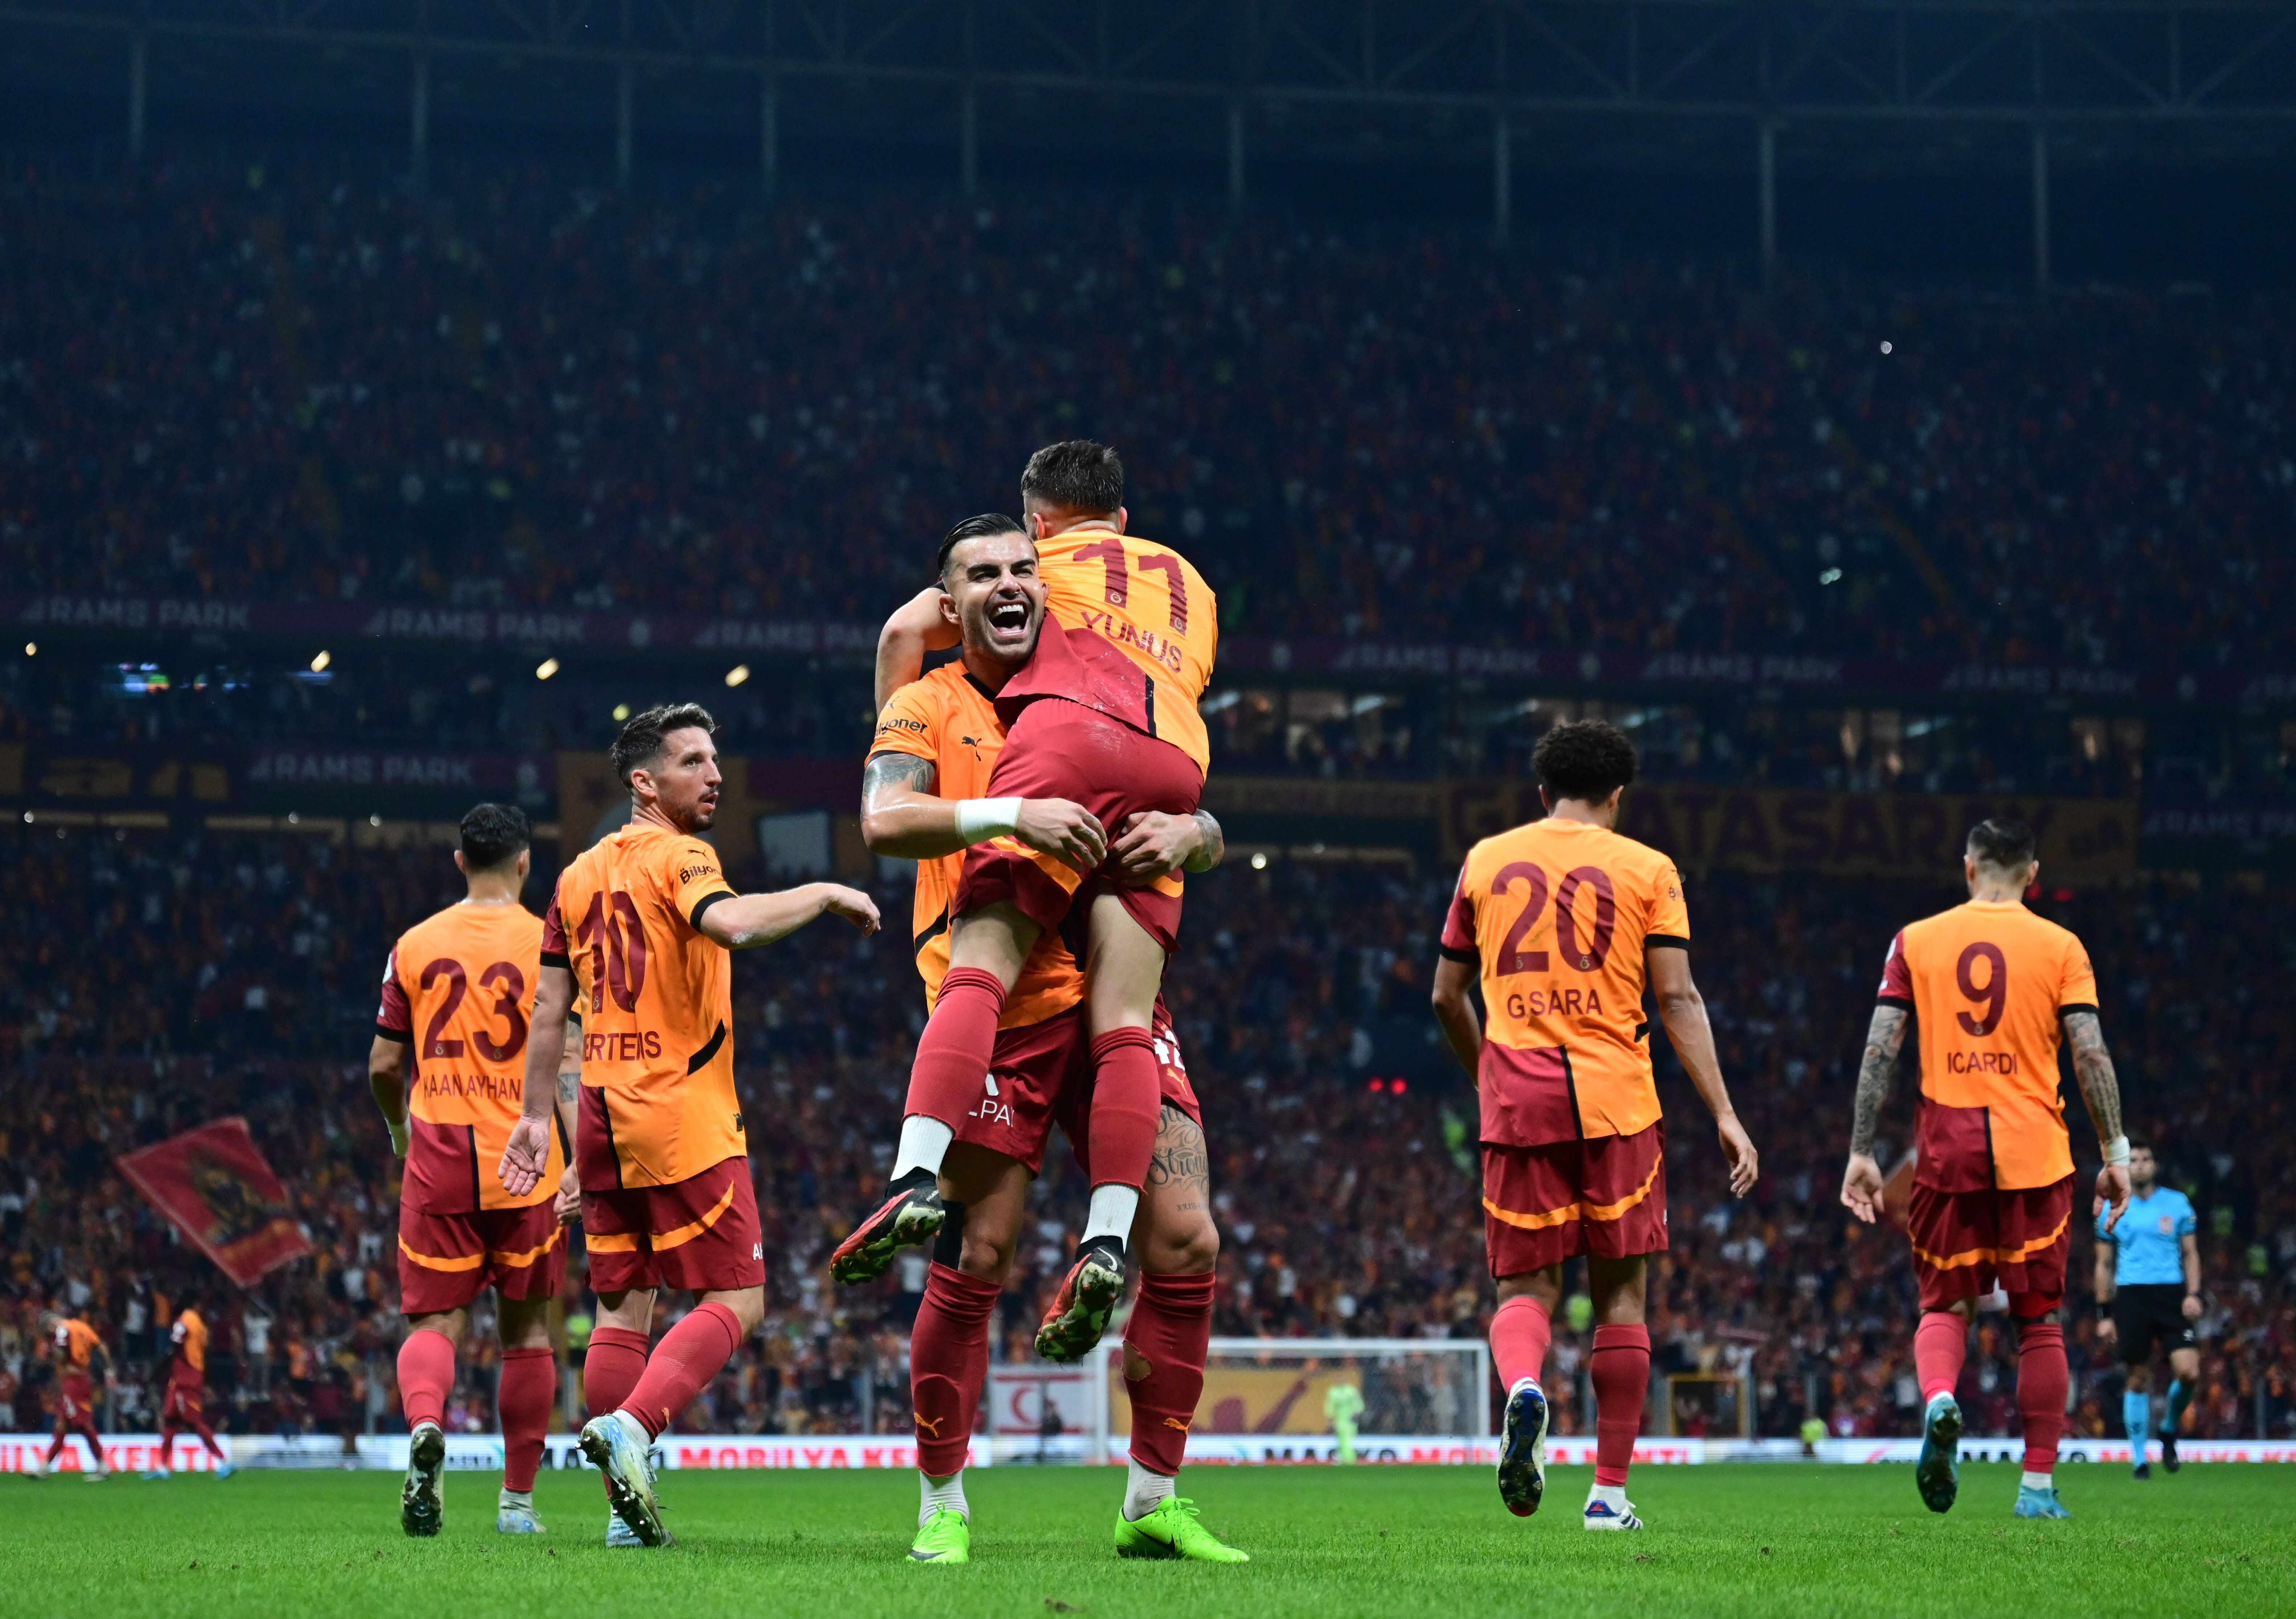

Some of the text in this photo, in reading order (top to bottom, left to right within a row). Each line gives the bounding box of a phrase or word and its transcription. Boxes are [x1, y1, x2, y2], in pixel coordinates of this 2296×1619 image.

[49, 595, 250, 631] RAMS PARK
[1073, 538, 1188, 636] 11
[1080, 612, 1183, 674] YUNUS
[275, 753, 474, 787] RAMS PARK
[1491, 862, 1615, 976] 20
[576, 890, 646, 1014] 10
[420, 958, 526, 1062] 23
[1956, 942, 2007, 1037] 9
[582, 1031, 662, 1062] ERTENS
[1947, 1052, 2018, 1074] ICARDI
[423, 1074, 521, 1101] KAAN AYHAN
